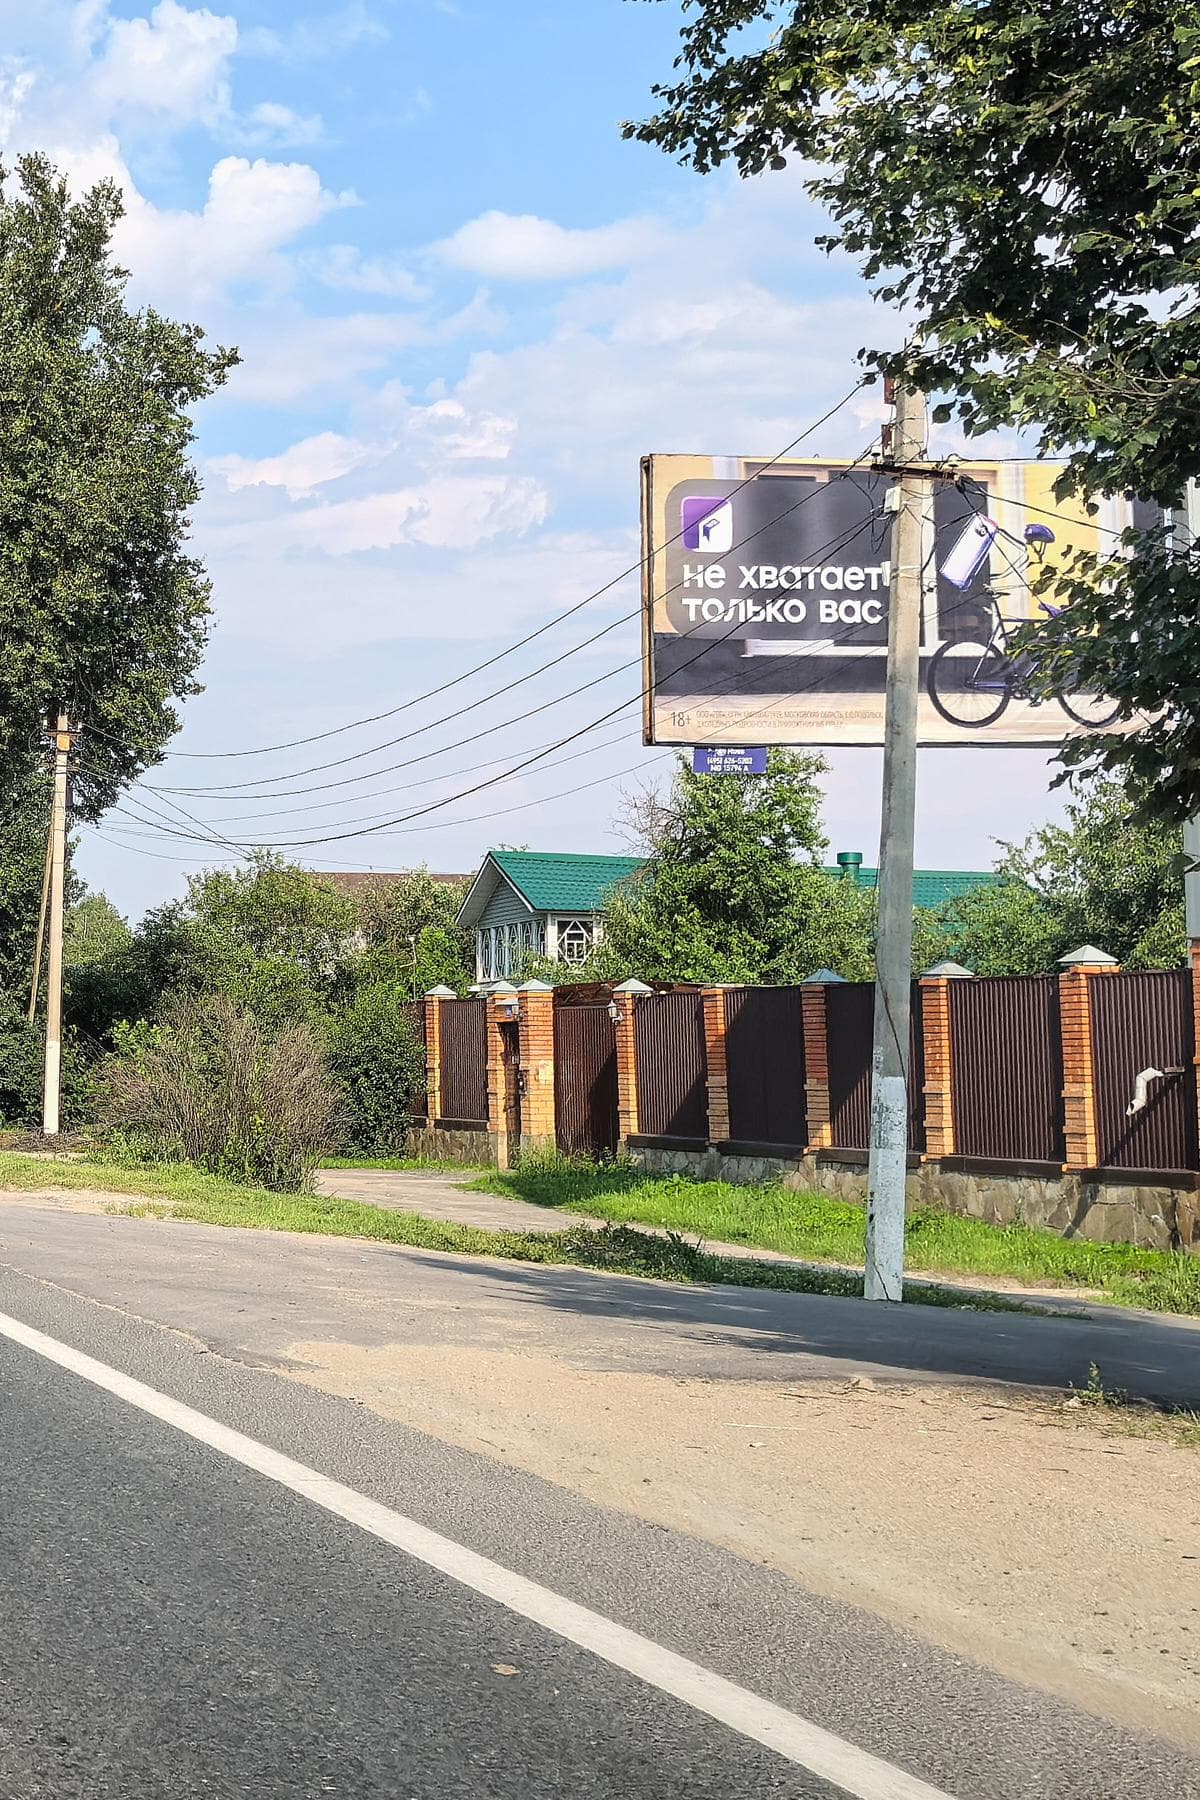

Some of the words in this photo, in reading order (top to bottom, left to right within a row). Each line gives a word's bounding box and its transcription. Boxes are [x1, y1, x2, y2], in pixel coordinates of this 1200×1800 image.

[682, 564, 727, 589] не
[738, 564, 884, 590] хватает
[682, 598, 807, 624] только
[819, 599, 884, 625] вас
[670, 711, 692, 728] 18+
